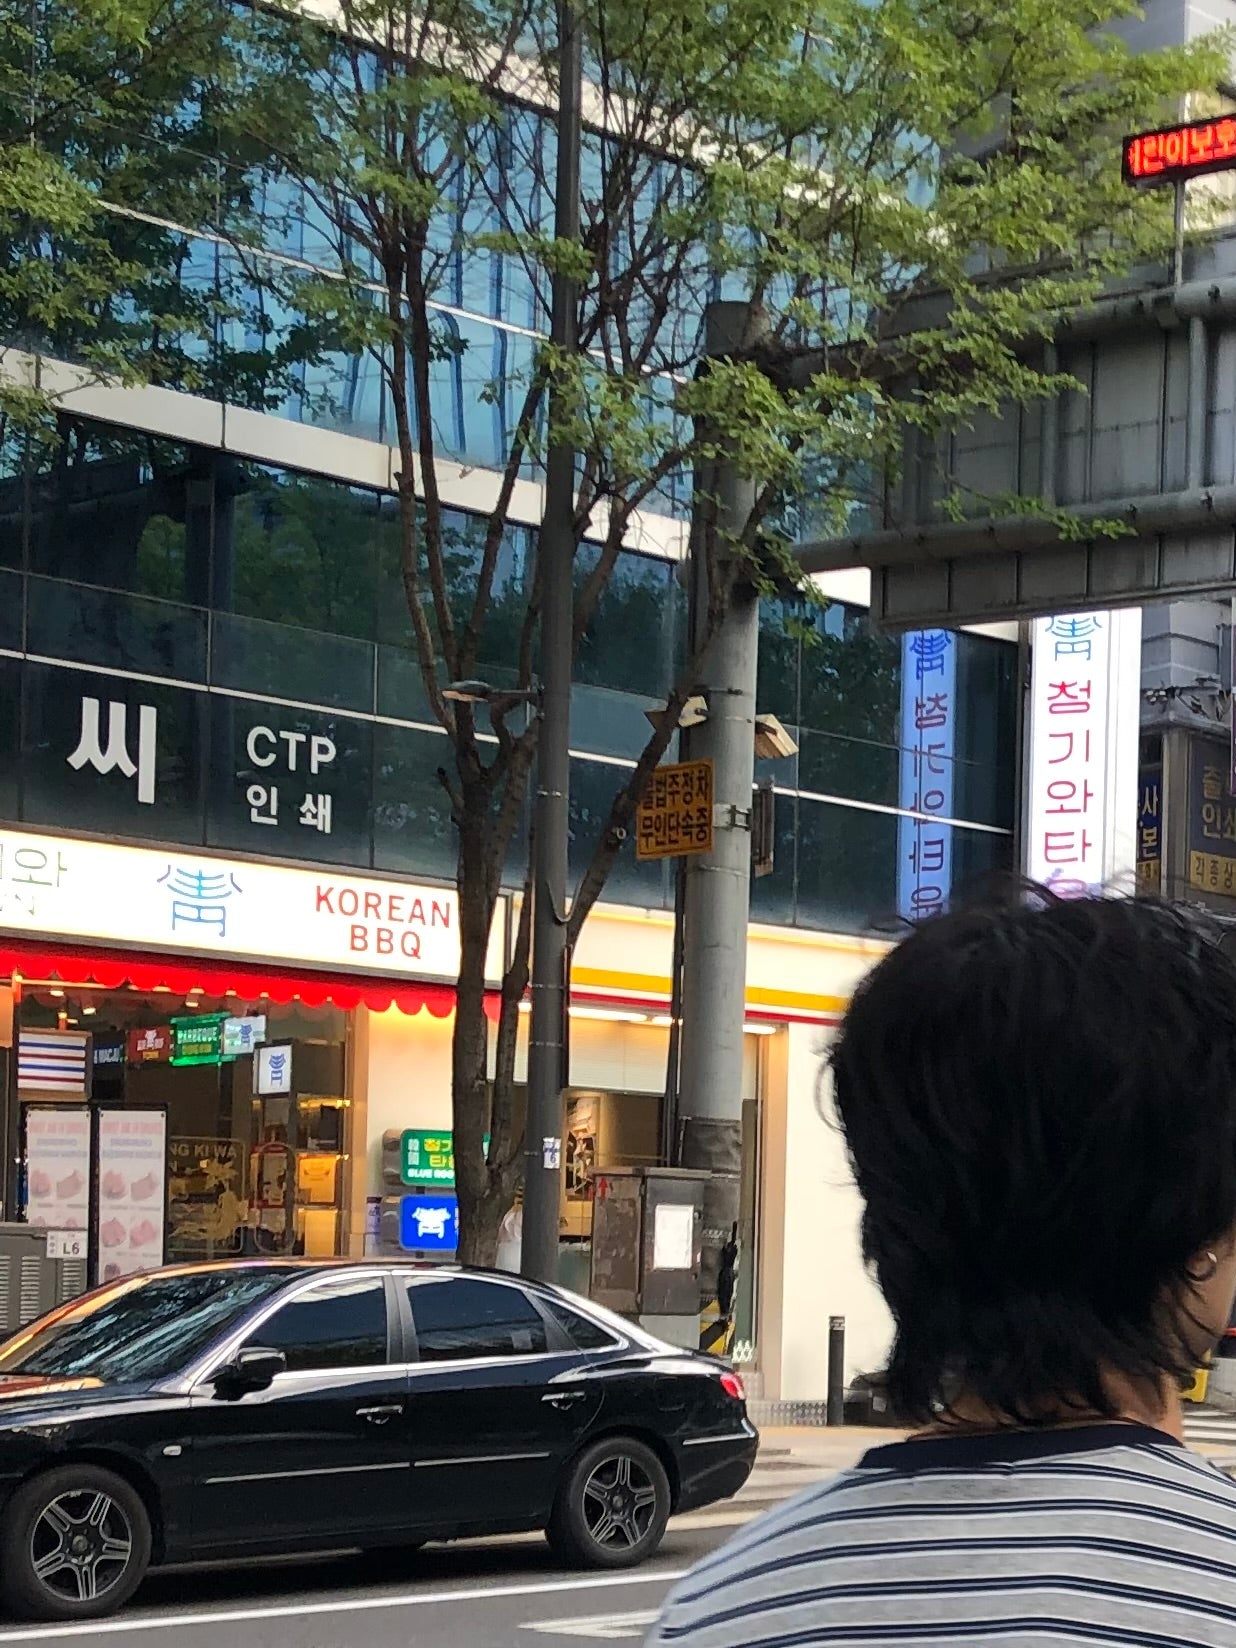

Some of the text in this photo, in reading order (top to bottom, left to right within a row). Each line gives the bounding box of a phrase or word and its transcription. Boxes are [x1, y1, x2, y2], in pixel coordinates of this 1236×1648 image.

[66, 696, 157, 805] 씨
[245, 725, 337, 775] CTP
[640, 807, 709, 850] 무인단속중
[0, 843, 68, 888] 와
[315, 885, 451, 929] KOREAN
[349, 924, 421, 960] BBQ
[62, 1241, 80, 1255] L6
